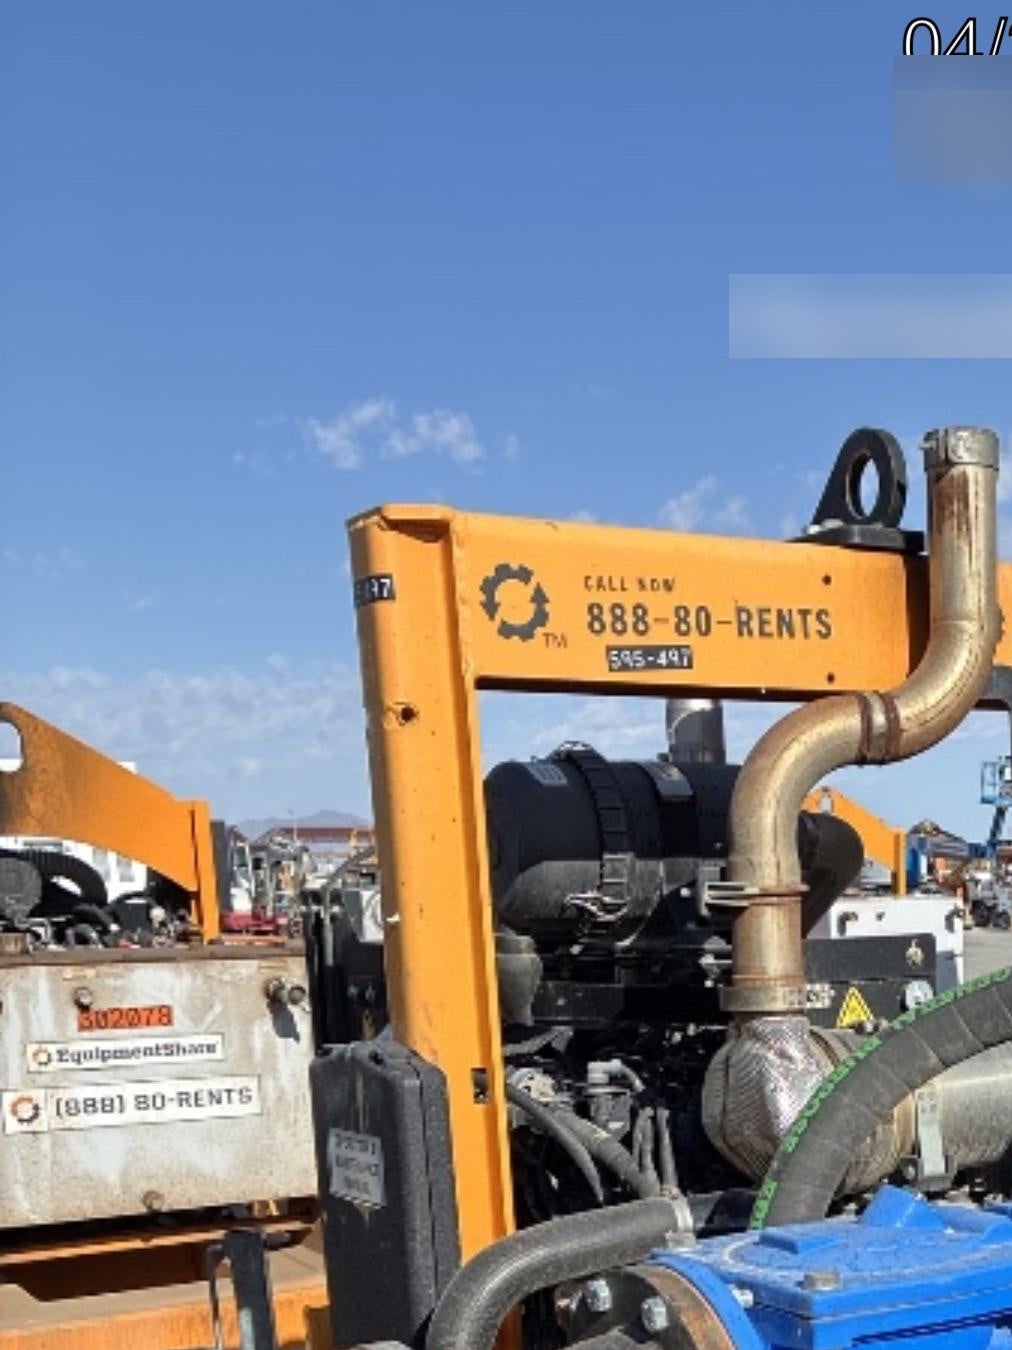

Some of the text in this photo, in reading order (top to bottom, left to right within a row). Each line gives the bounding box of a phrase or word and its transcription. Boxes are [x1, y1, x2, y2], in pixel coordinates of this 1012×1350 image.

[584, 575, 628, 592] CALL
[586, 603, 833, 640] 888-80-RENTS
[608, 648, 692, 669] 595-497
[56, 1042, 217, 1066] EquipmentShare
[134, 1087, 253, 1112] 80-RENTS
